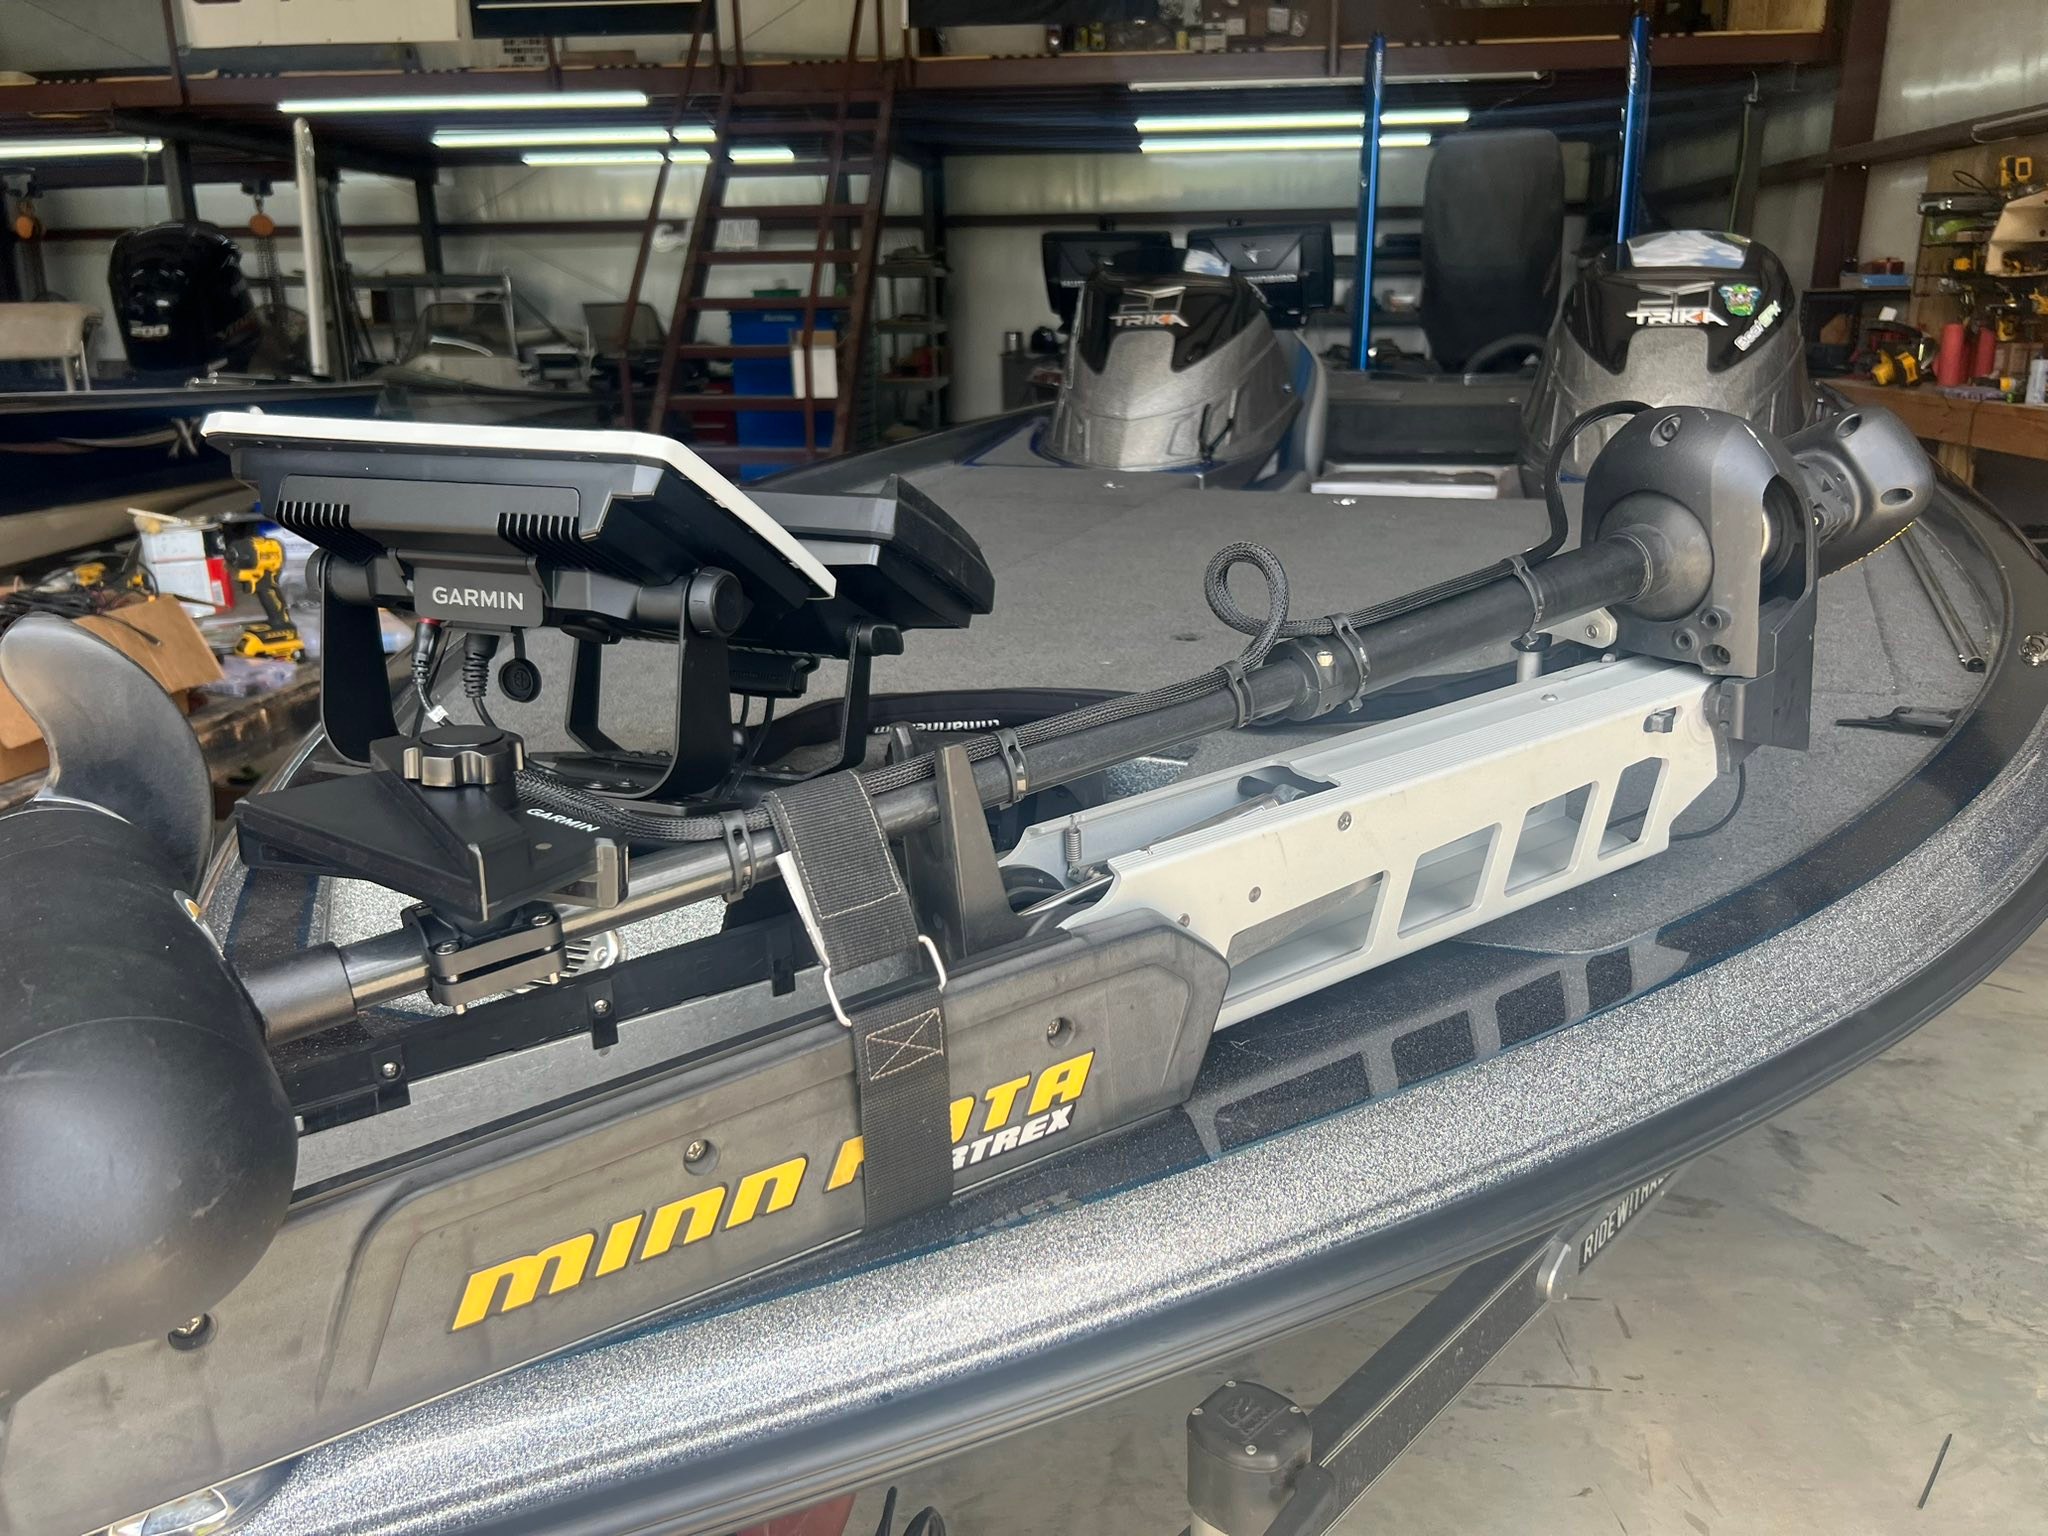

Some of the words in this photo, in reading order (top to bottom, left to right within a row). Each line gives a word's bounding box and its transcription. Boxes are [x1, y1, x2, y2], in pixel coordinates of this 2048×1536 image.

[1109, 313, 1190, 328] TRIKA
[1625, 309, 1729, 327] TRIKA
[432, 586, 524, 611] GARMIN
[526, 808, 601, 832] GARMIN
[952, 1104, 1074, 1171] RTREX
